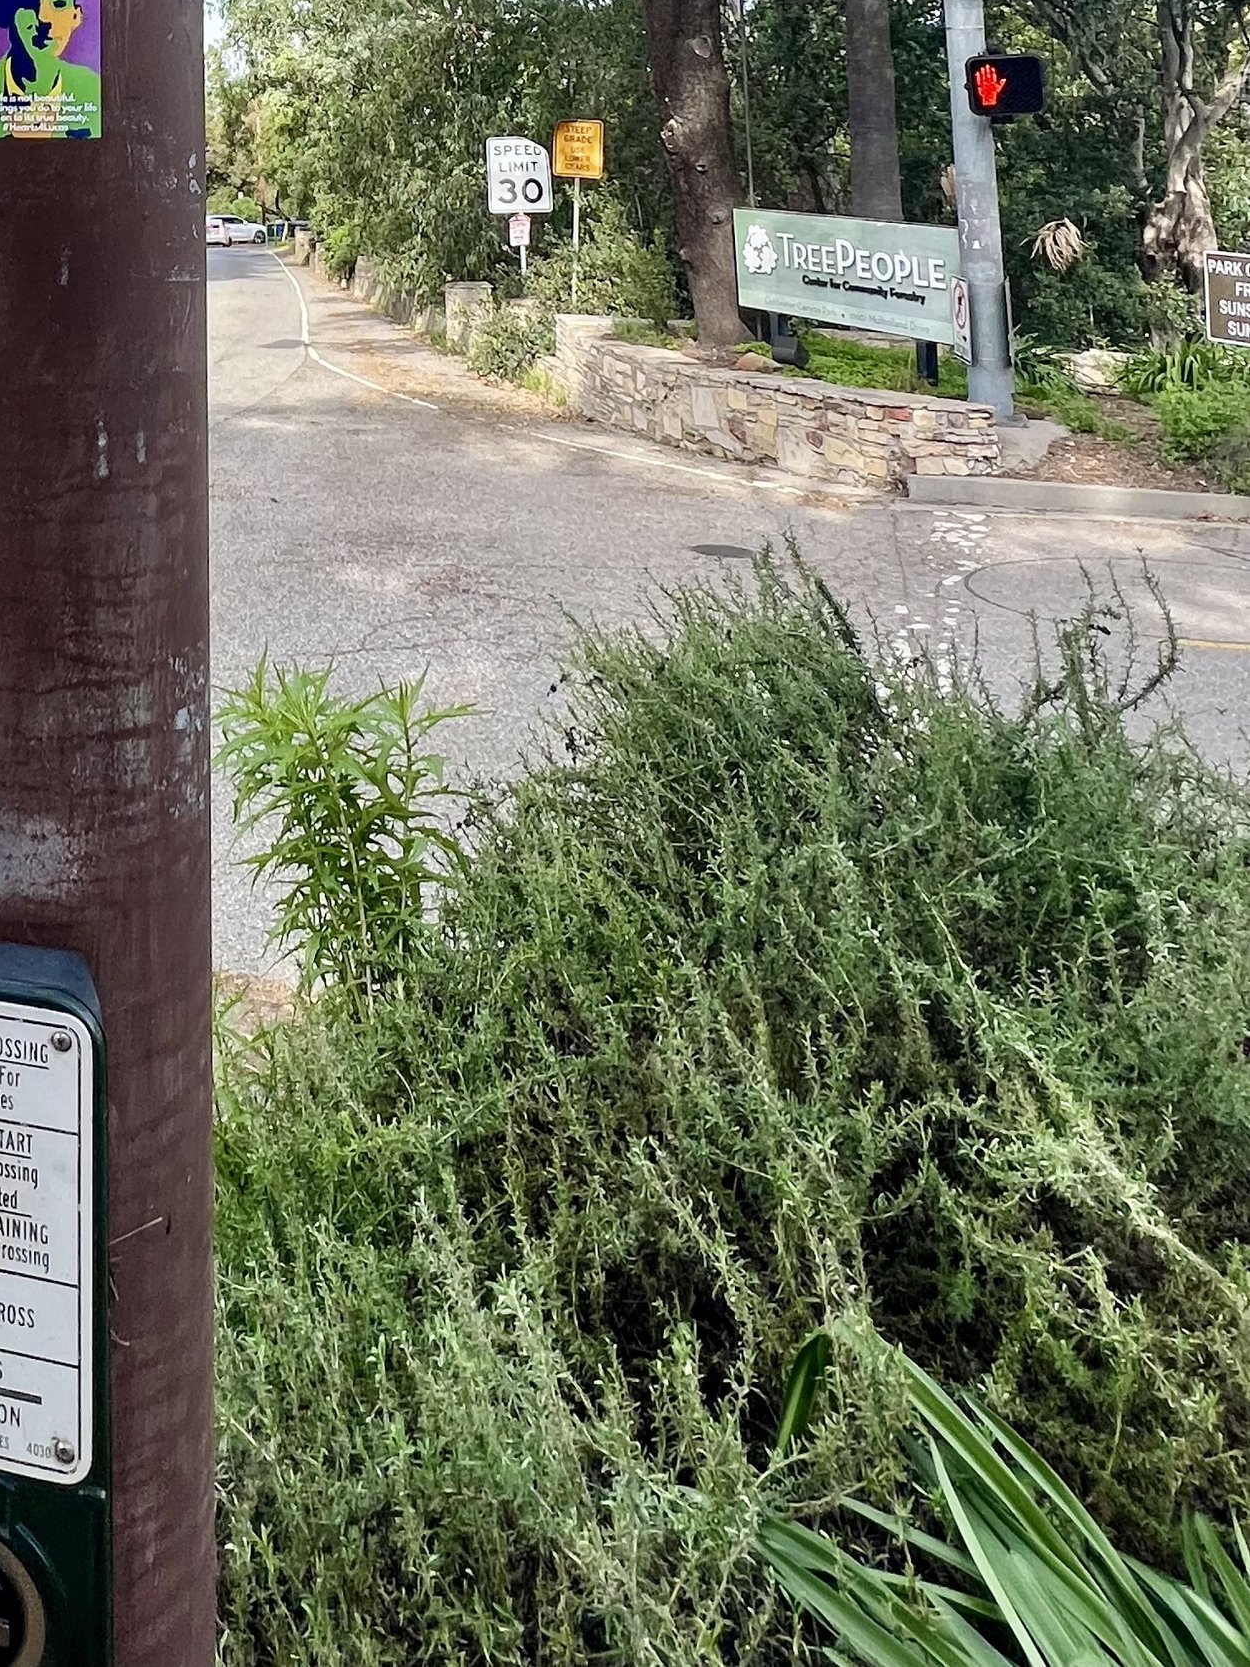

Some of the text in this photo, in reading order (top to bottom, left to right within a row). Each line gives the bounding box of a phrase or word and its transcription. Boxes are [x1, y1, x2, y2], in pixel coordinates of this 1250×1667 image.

[9, 93, 17, 102] is
[17, 94, 33, 102] not
[19, 105, 37, 114] you
[37, 103, 49, 112] do
[51, 103, 61, 112] to
[62, 105, 83, 114] your
[84, 102, 97, 112] life
[14, 113, 23, 122] to
[565, 125, 592, 134] STEEP
[564, 135, 592, 144] GRADE
[494, 144, 542, 156] SPEED
[499, 161, 538, 172] LIMIT
[498, 178, 543, 203] 30
[1207, 258, 1243, 276] PARK
[0, 1065, 21, 1087] For
